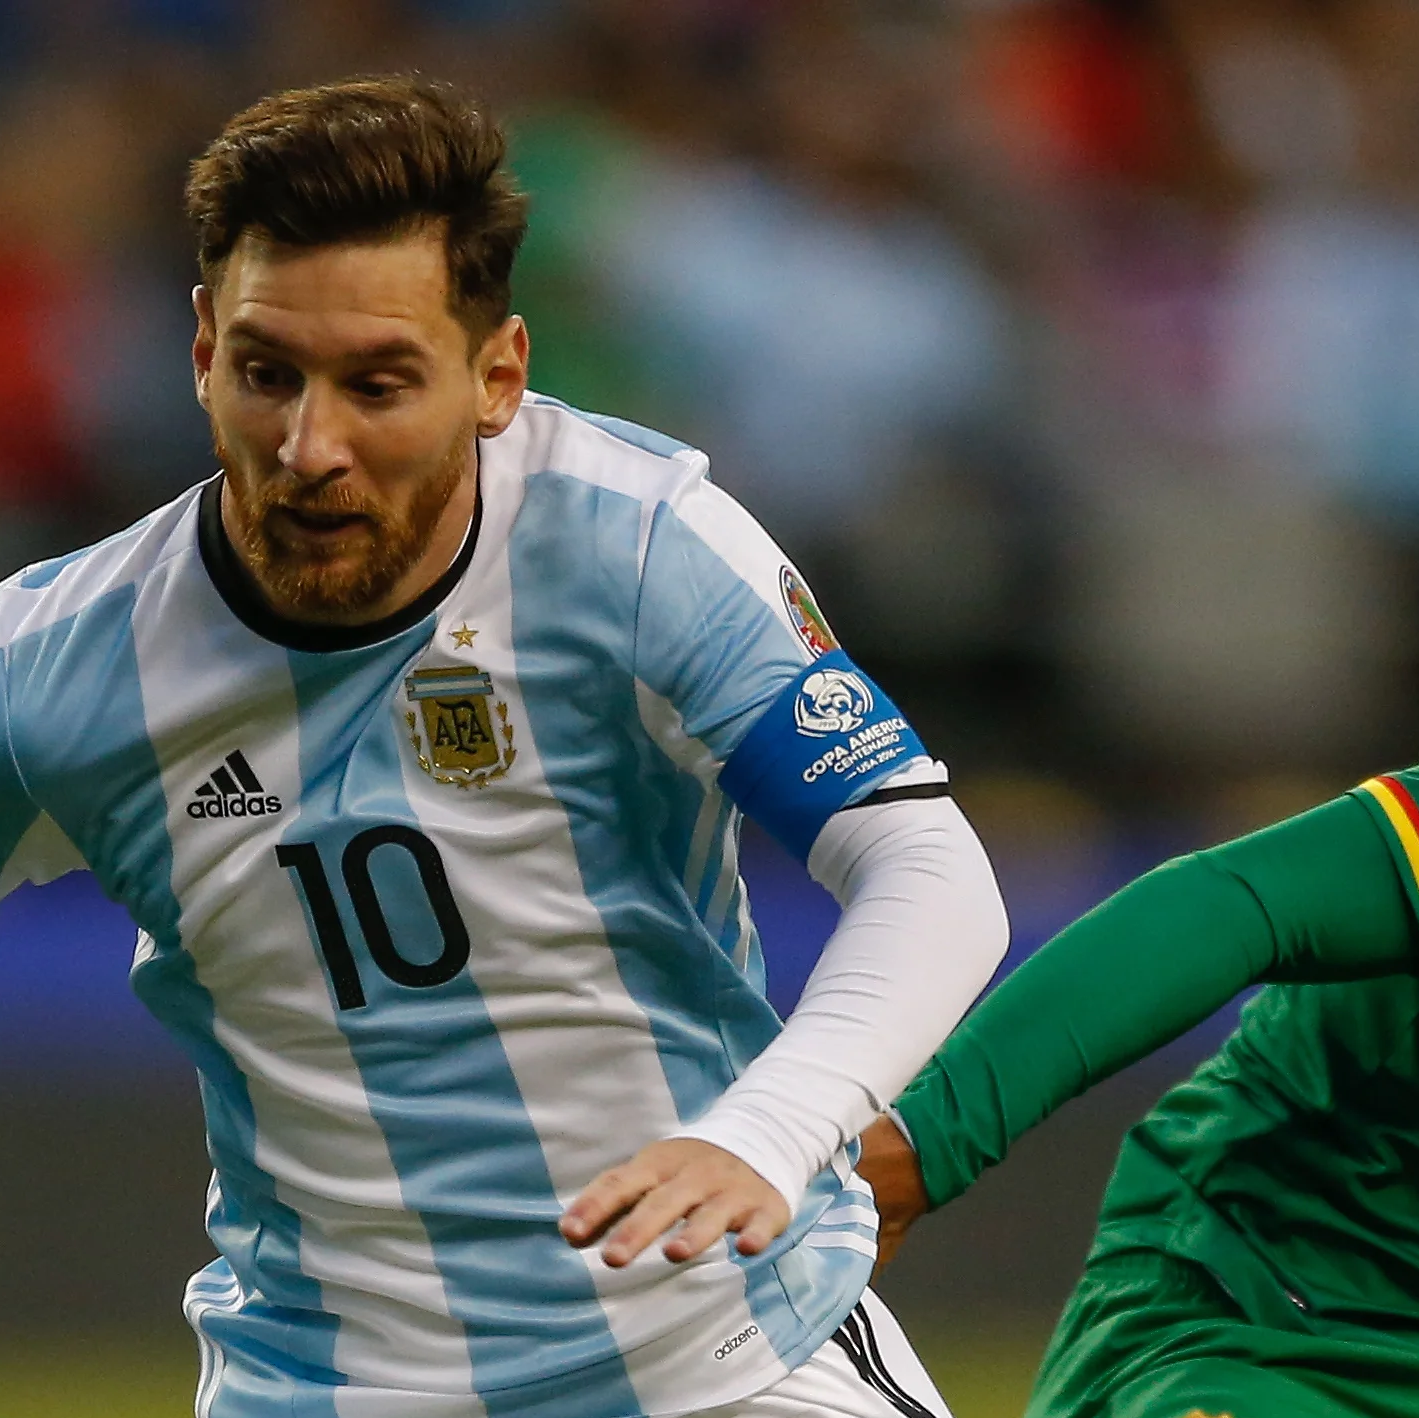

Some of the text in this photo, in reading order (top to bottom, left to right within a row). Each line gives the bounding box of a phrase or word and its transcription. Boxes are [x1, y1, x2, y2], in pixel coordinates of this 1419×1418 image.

[434, 700, 491, 754] AFA
[803, 745, 849, 783] COPA
[833, 732, 900, 774] CENTENARIO
[856, 757, 879, 774] USA
[186, 794, 283, 819] adidas
[274, 824, 471, 1011] 10
[714, 1325, 759, 1361] adizero
